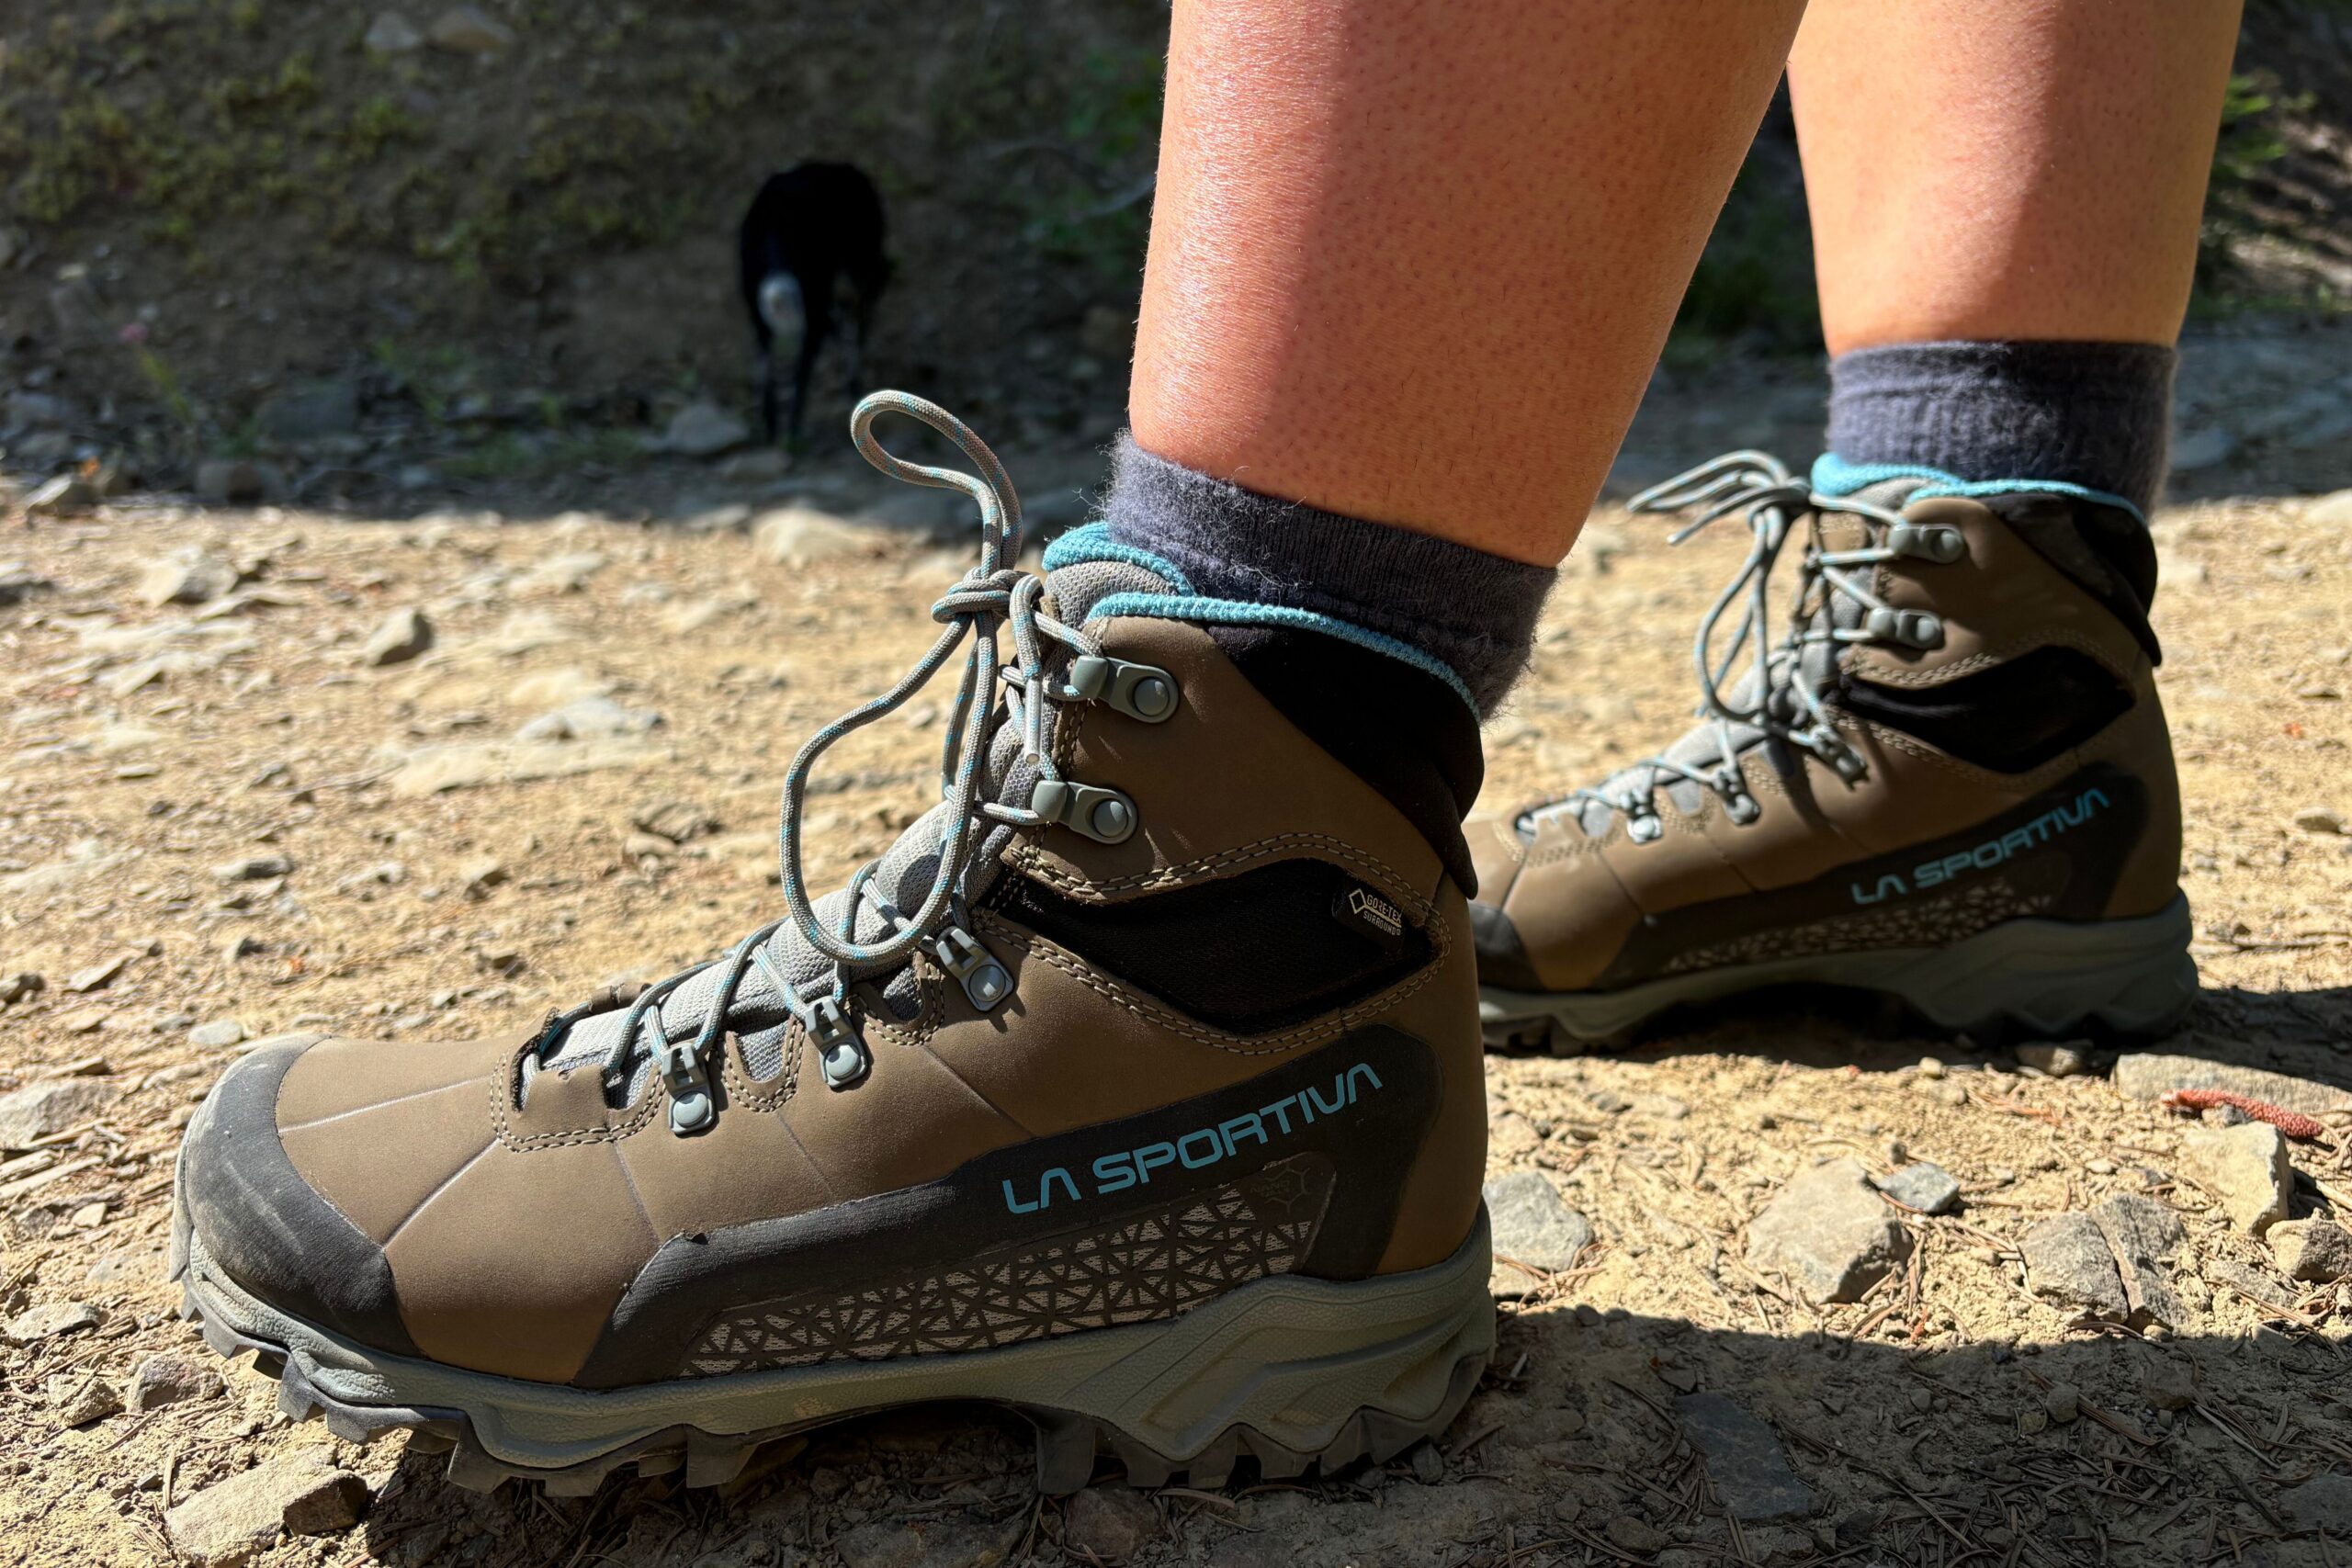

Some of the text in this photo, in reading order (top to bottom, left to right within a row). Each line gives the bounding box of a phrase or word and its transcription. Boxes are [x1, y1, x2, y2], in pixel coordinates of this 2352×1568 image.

[1851, 788, 2109, 905] LA SPORTIVA
[1367, 894, 1400, 922] GORE-TEX
[1002, 1063, 1384, 1214] LA SPORTIVA
